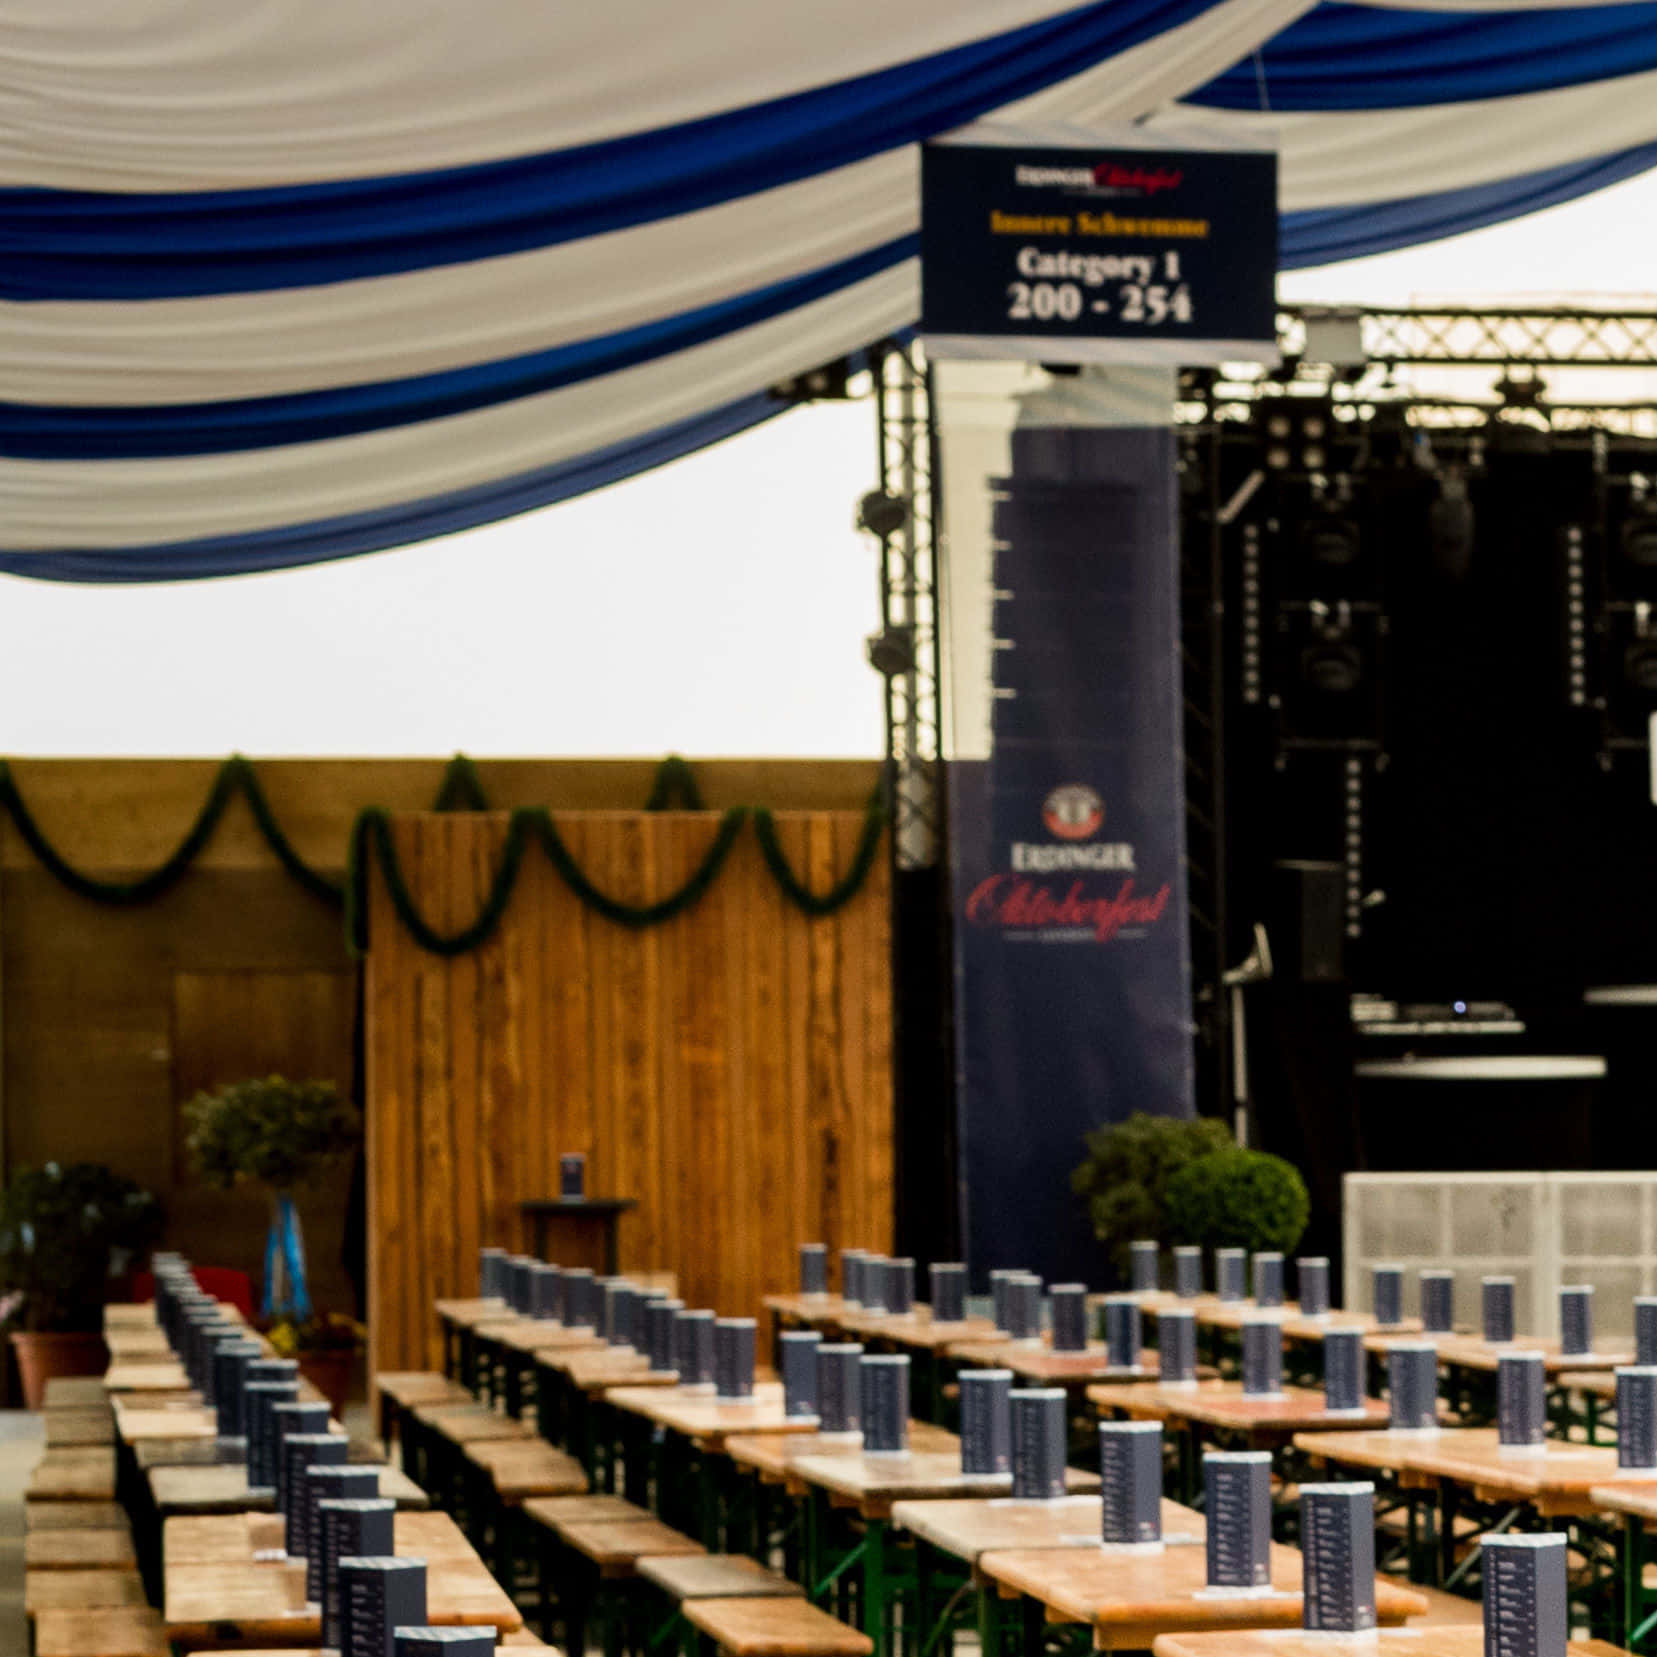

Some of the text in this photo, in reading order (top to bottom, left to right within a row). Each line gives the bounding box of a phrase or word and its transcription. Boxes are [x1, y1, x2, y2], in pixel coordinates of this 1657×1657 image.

[1017, 246, 1181, 286] Category 1
[1008, 284, 1082, 320] 200
[1120, 284, 1194, 324] 254
